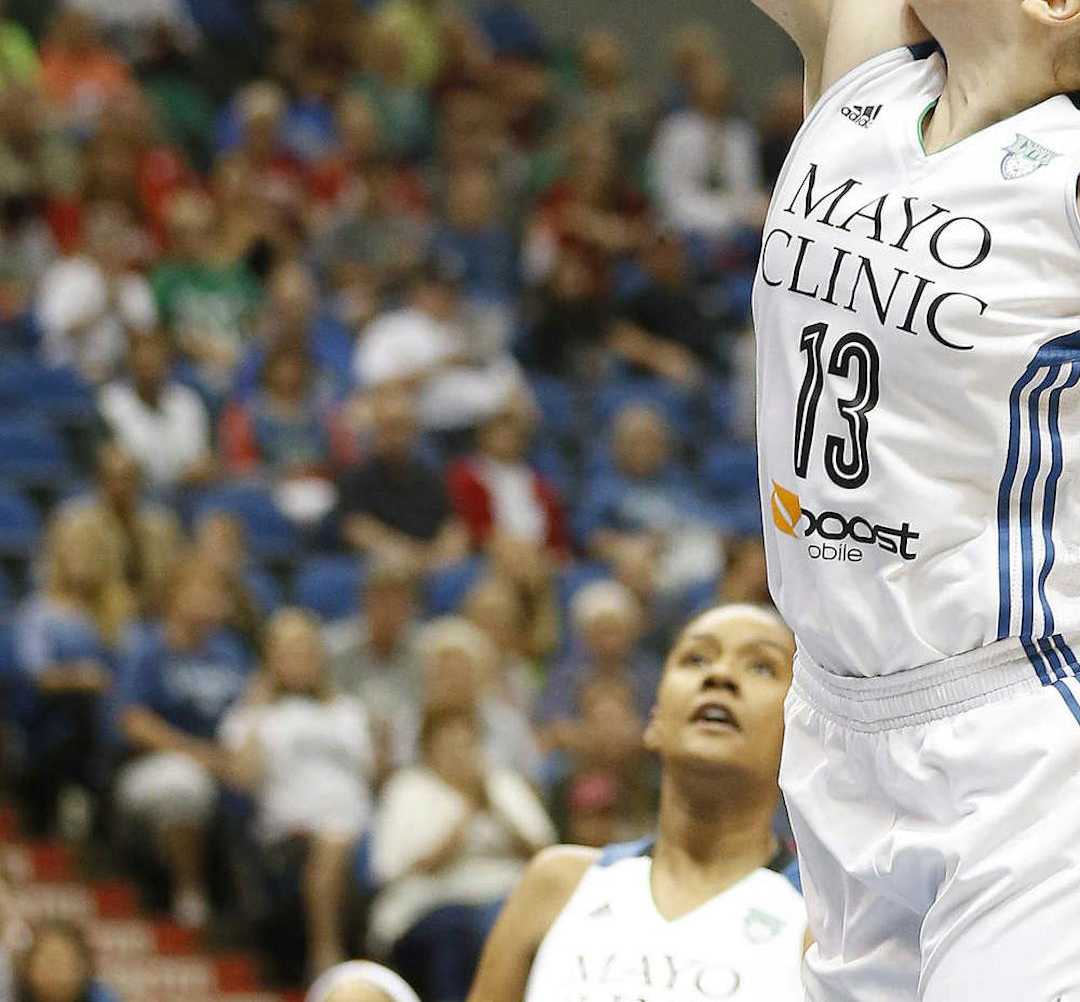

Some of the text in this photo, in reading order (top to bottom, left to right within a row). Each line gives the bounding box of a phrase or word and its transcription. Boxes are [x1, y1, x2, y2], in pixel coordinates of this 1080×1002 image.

[784, 163, 992, 269] MAYO
[761, 229, 989, 350] CLINIC
[794, 322, 880, 489] 13
